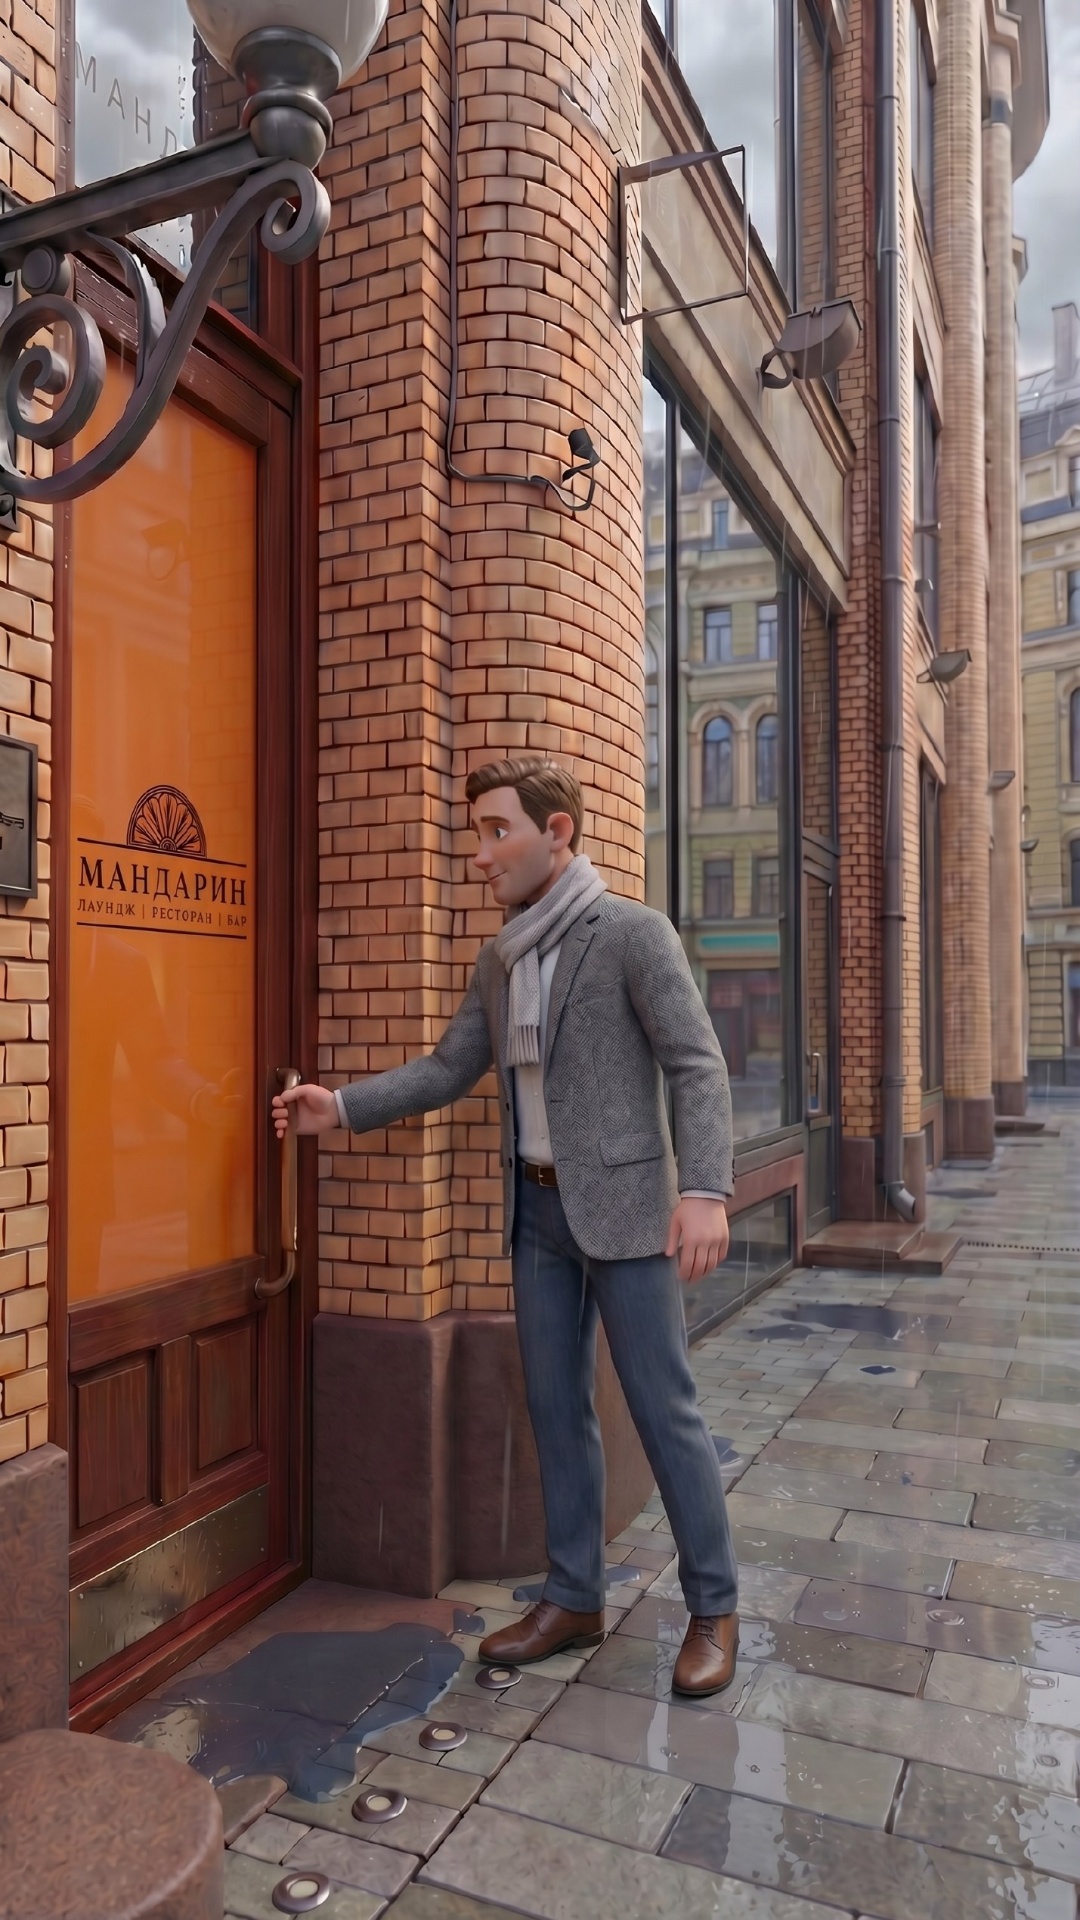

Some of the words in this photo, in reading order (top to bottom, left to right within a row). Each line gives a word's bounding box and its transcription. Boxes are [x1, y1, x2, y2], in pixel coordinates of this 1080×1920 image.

[78, 856, 246, 906] МАНДАРИН
[77, 899, 136, 917] ЛАУНДЖ
[152, 906, 212, 924] РЕСТОРАН
[227, 914, 247, 927] БАР
